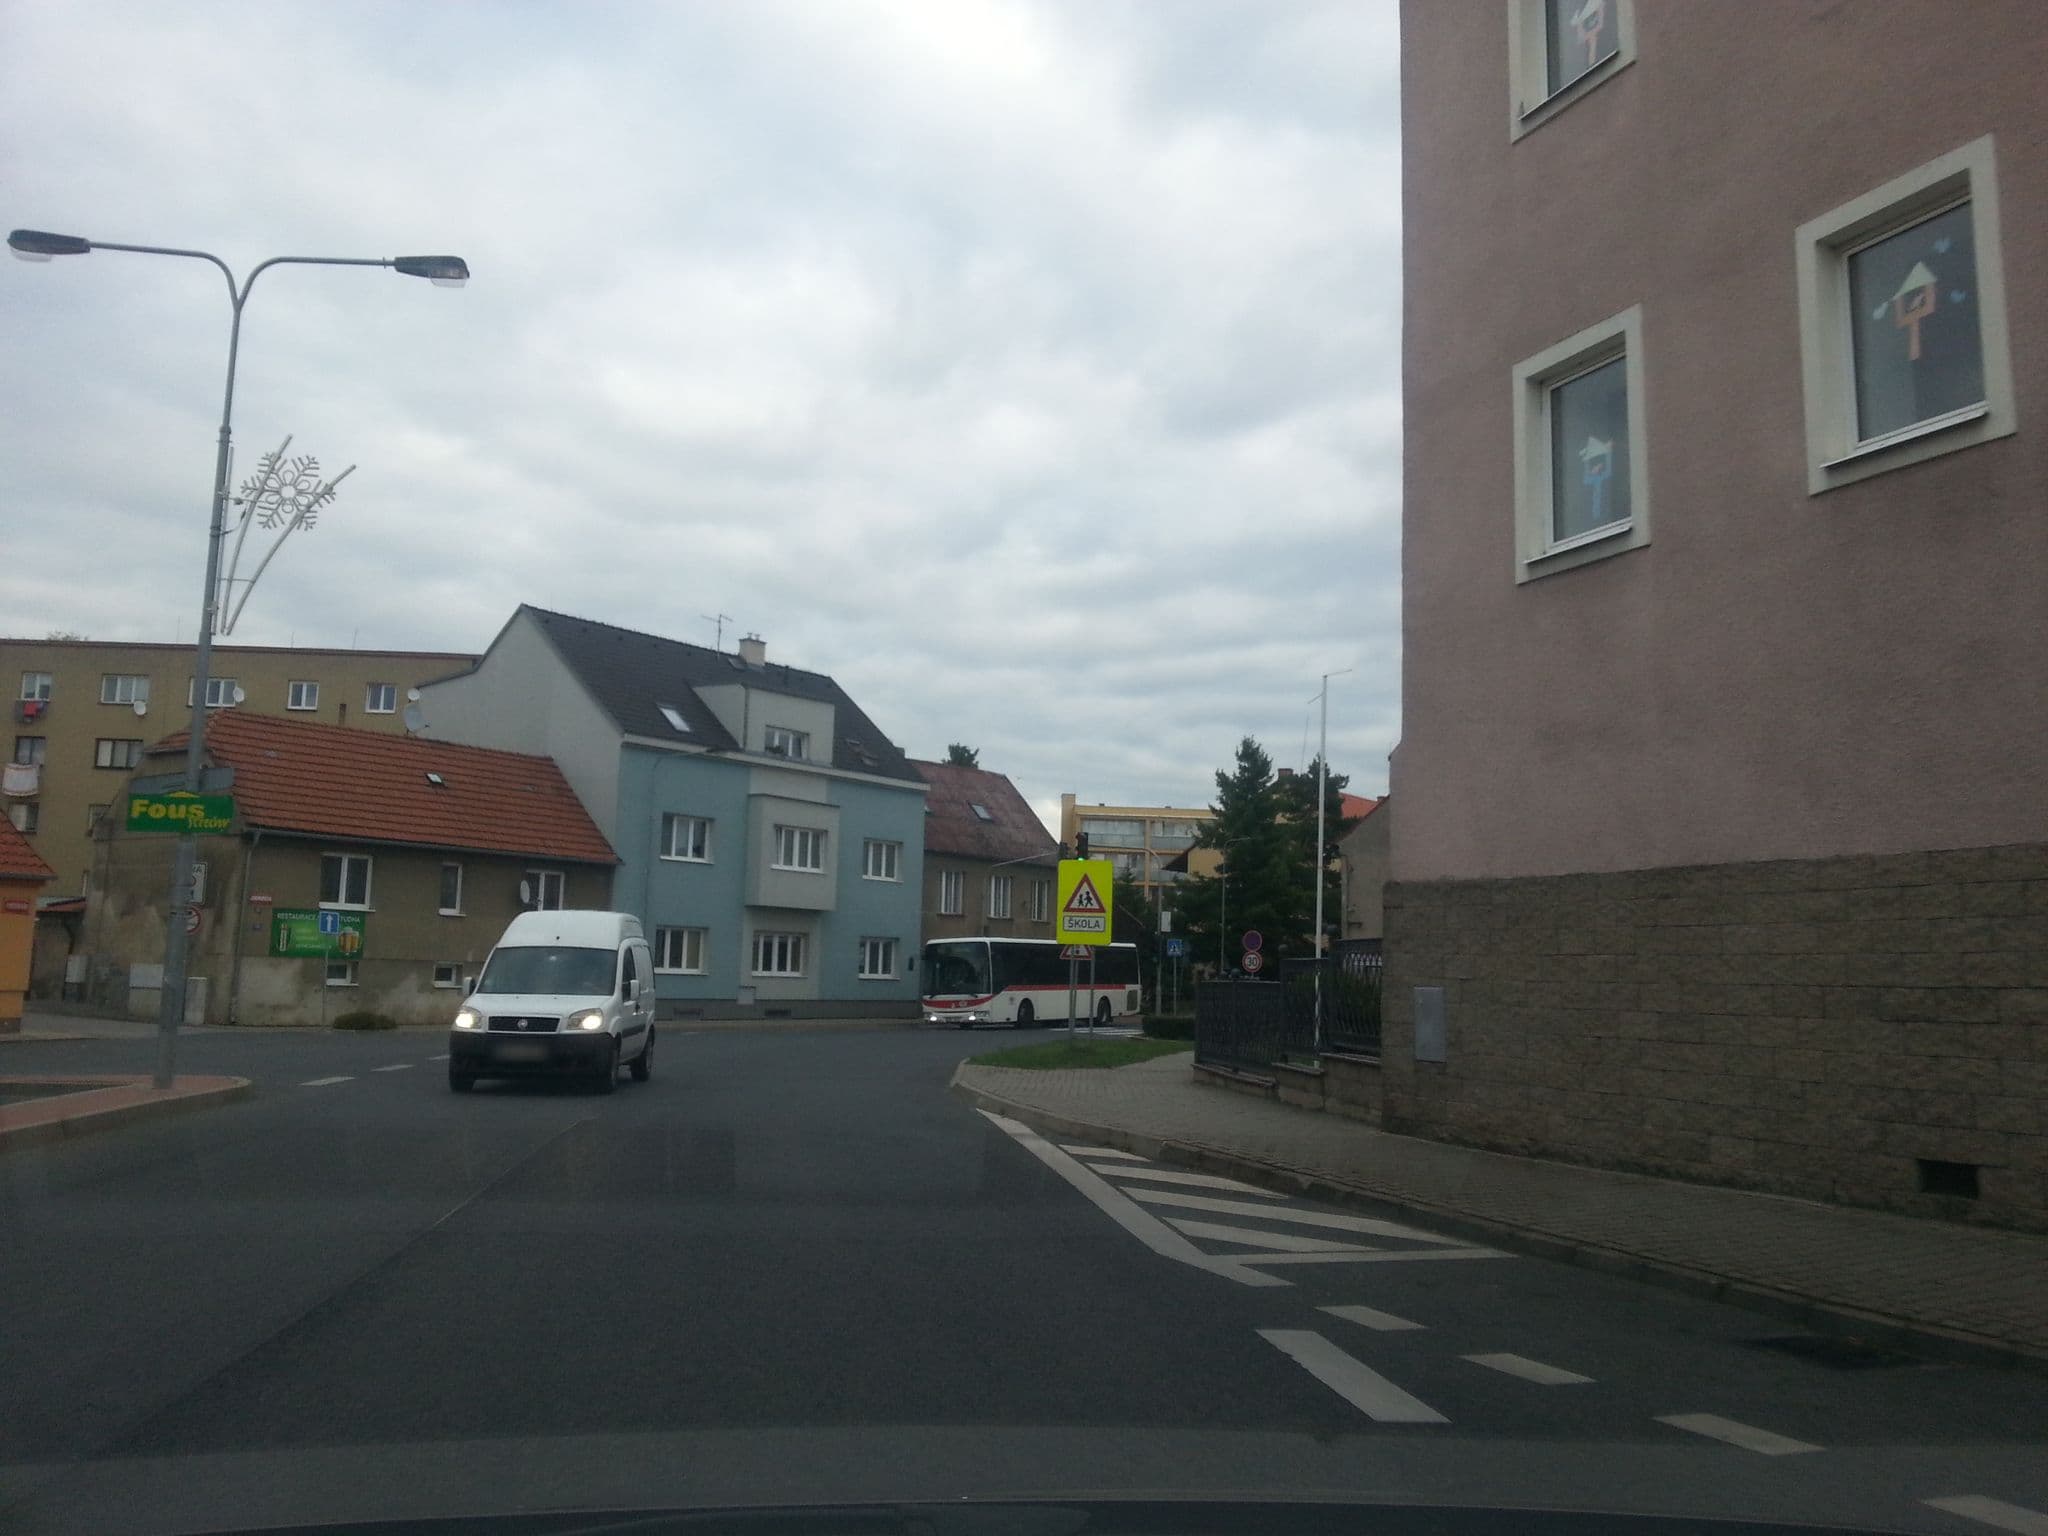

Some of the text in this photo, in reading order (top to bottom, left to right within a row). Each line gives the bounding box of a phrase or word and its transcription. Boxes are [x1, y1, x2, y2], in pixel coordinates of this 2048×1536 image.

[130, 799, 205, 820] Fous
[276, 912, 317, 921] RESTAURACE
[1068, 917, 1101, 929] ŠKOLA
[1247, 956, 1258, 967] 30
